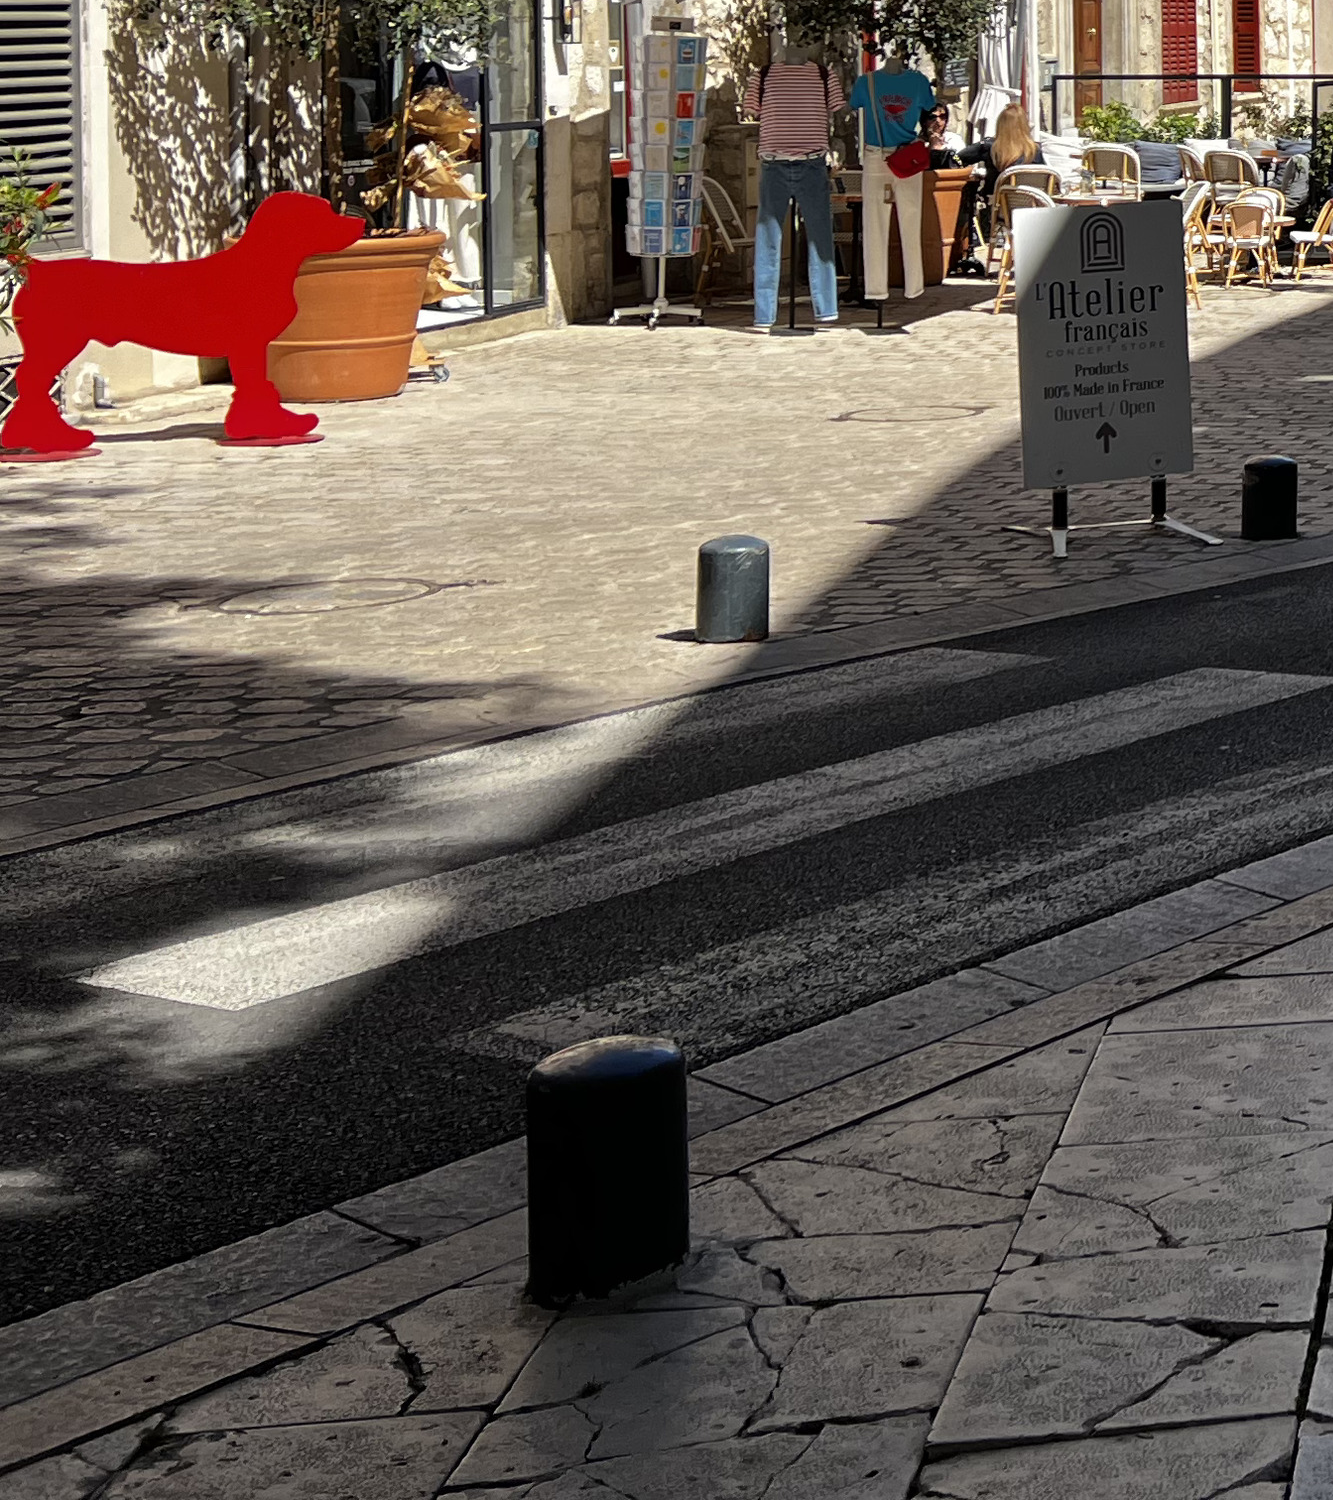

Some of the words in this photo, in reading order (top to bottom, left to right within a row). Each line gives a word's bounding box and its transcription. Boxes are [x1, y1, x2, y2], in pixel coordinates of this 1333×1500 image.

[1035, 278, 1164, 320] L'Atelier
[1065, 318, 1148, 343] français
[1046, 345, 1112, 358] CONCEPT
[1121, 340, 1166, 351] STORE
[1074, 360, 1130, 377] Products
[1043, 384, 1071, 400] 100%
[1073, 382, 1105, 397] Made
[1122, 378, 1165, 392] France
[1054, 402, 1106, 422] Ouvert
[1119, 399, 1156, 418] Open
